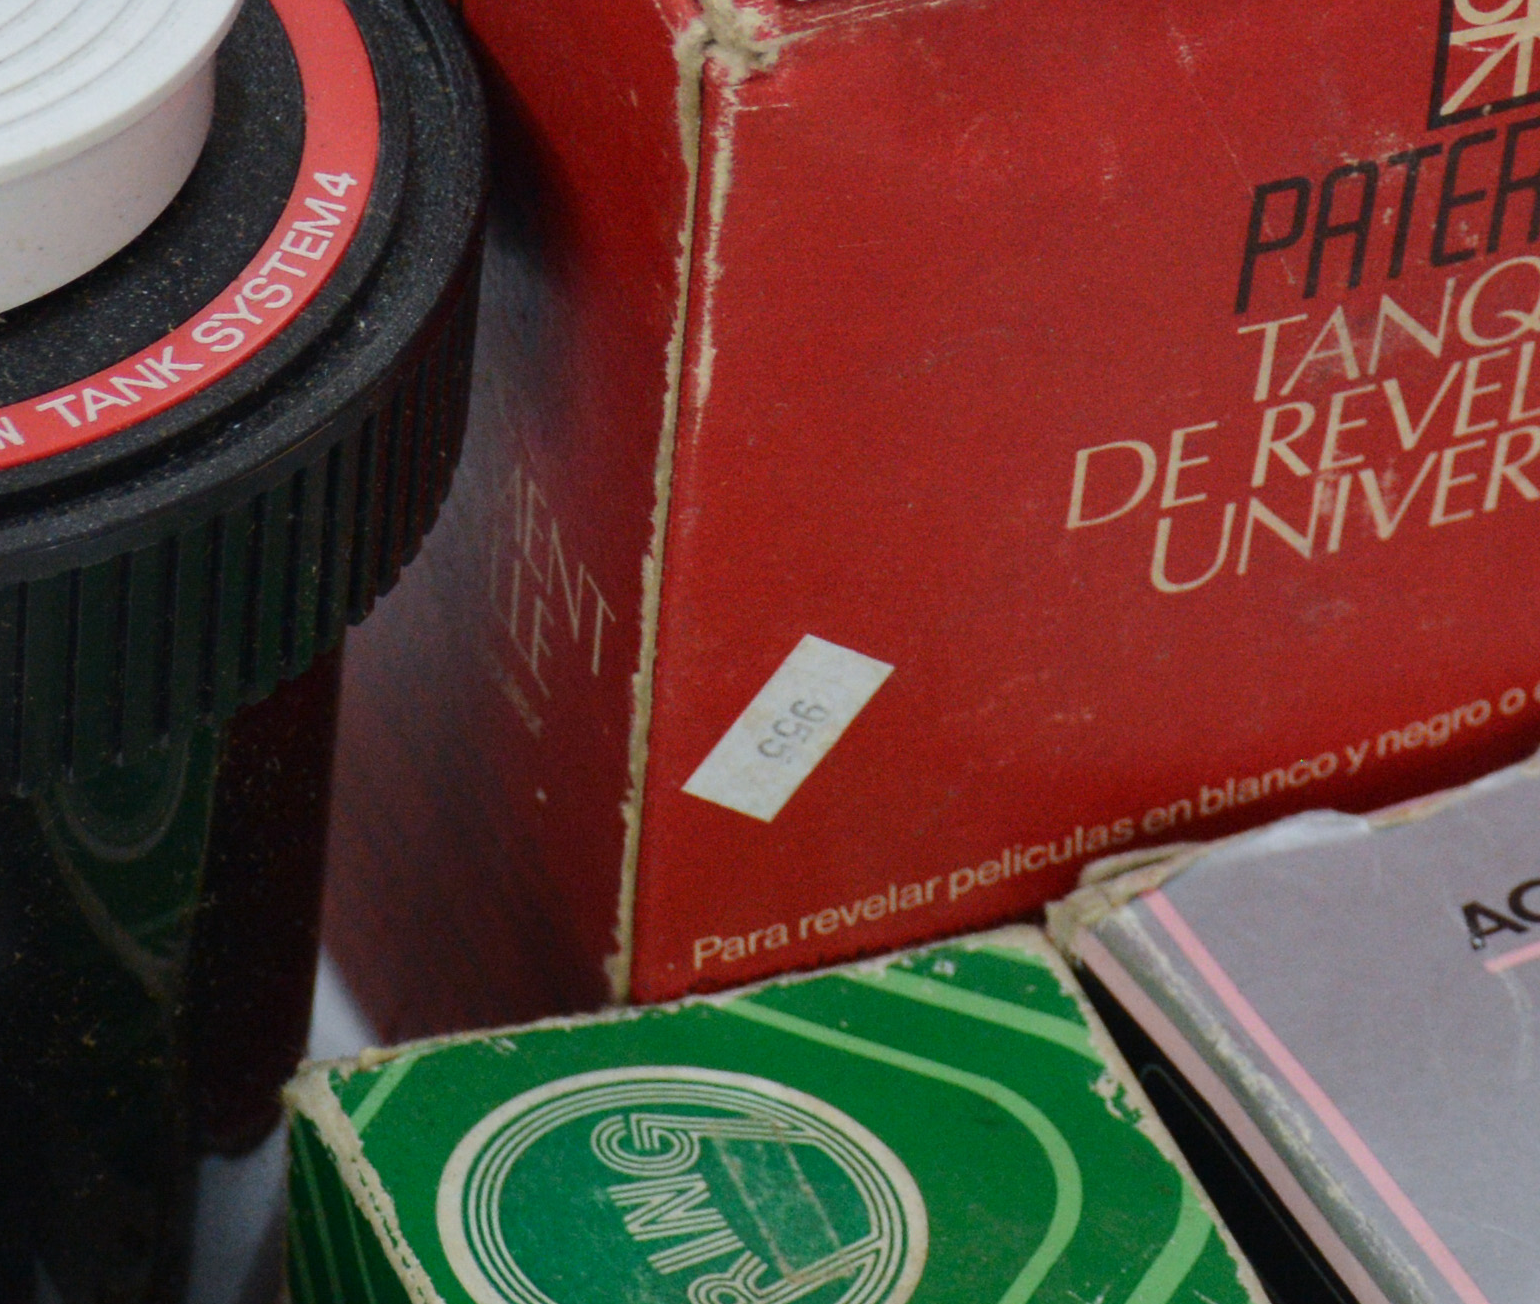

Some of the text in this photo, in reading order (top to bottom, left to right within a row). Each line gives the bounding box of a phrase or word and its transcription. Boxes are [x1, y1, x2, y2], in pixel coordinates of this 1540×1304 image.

[35, 346, 203, 429] TANK
[1066, 422, 1218, 529] DE
[692, 921, 790, 970] Para
[799, 877, 941, 940] revelar
[1143, 799, 1194, 835] en
[1199, 754, 1339, 817] blanco
[1345, 738, 1371, 773] y
[1376, 700, 1491, 760] negro
[1498, 687, 1527, 714] o
